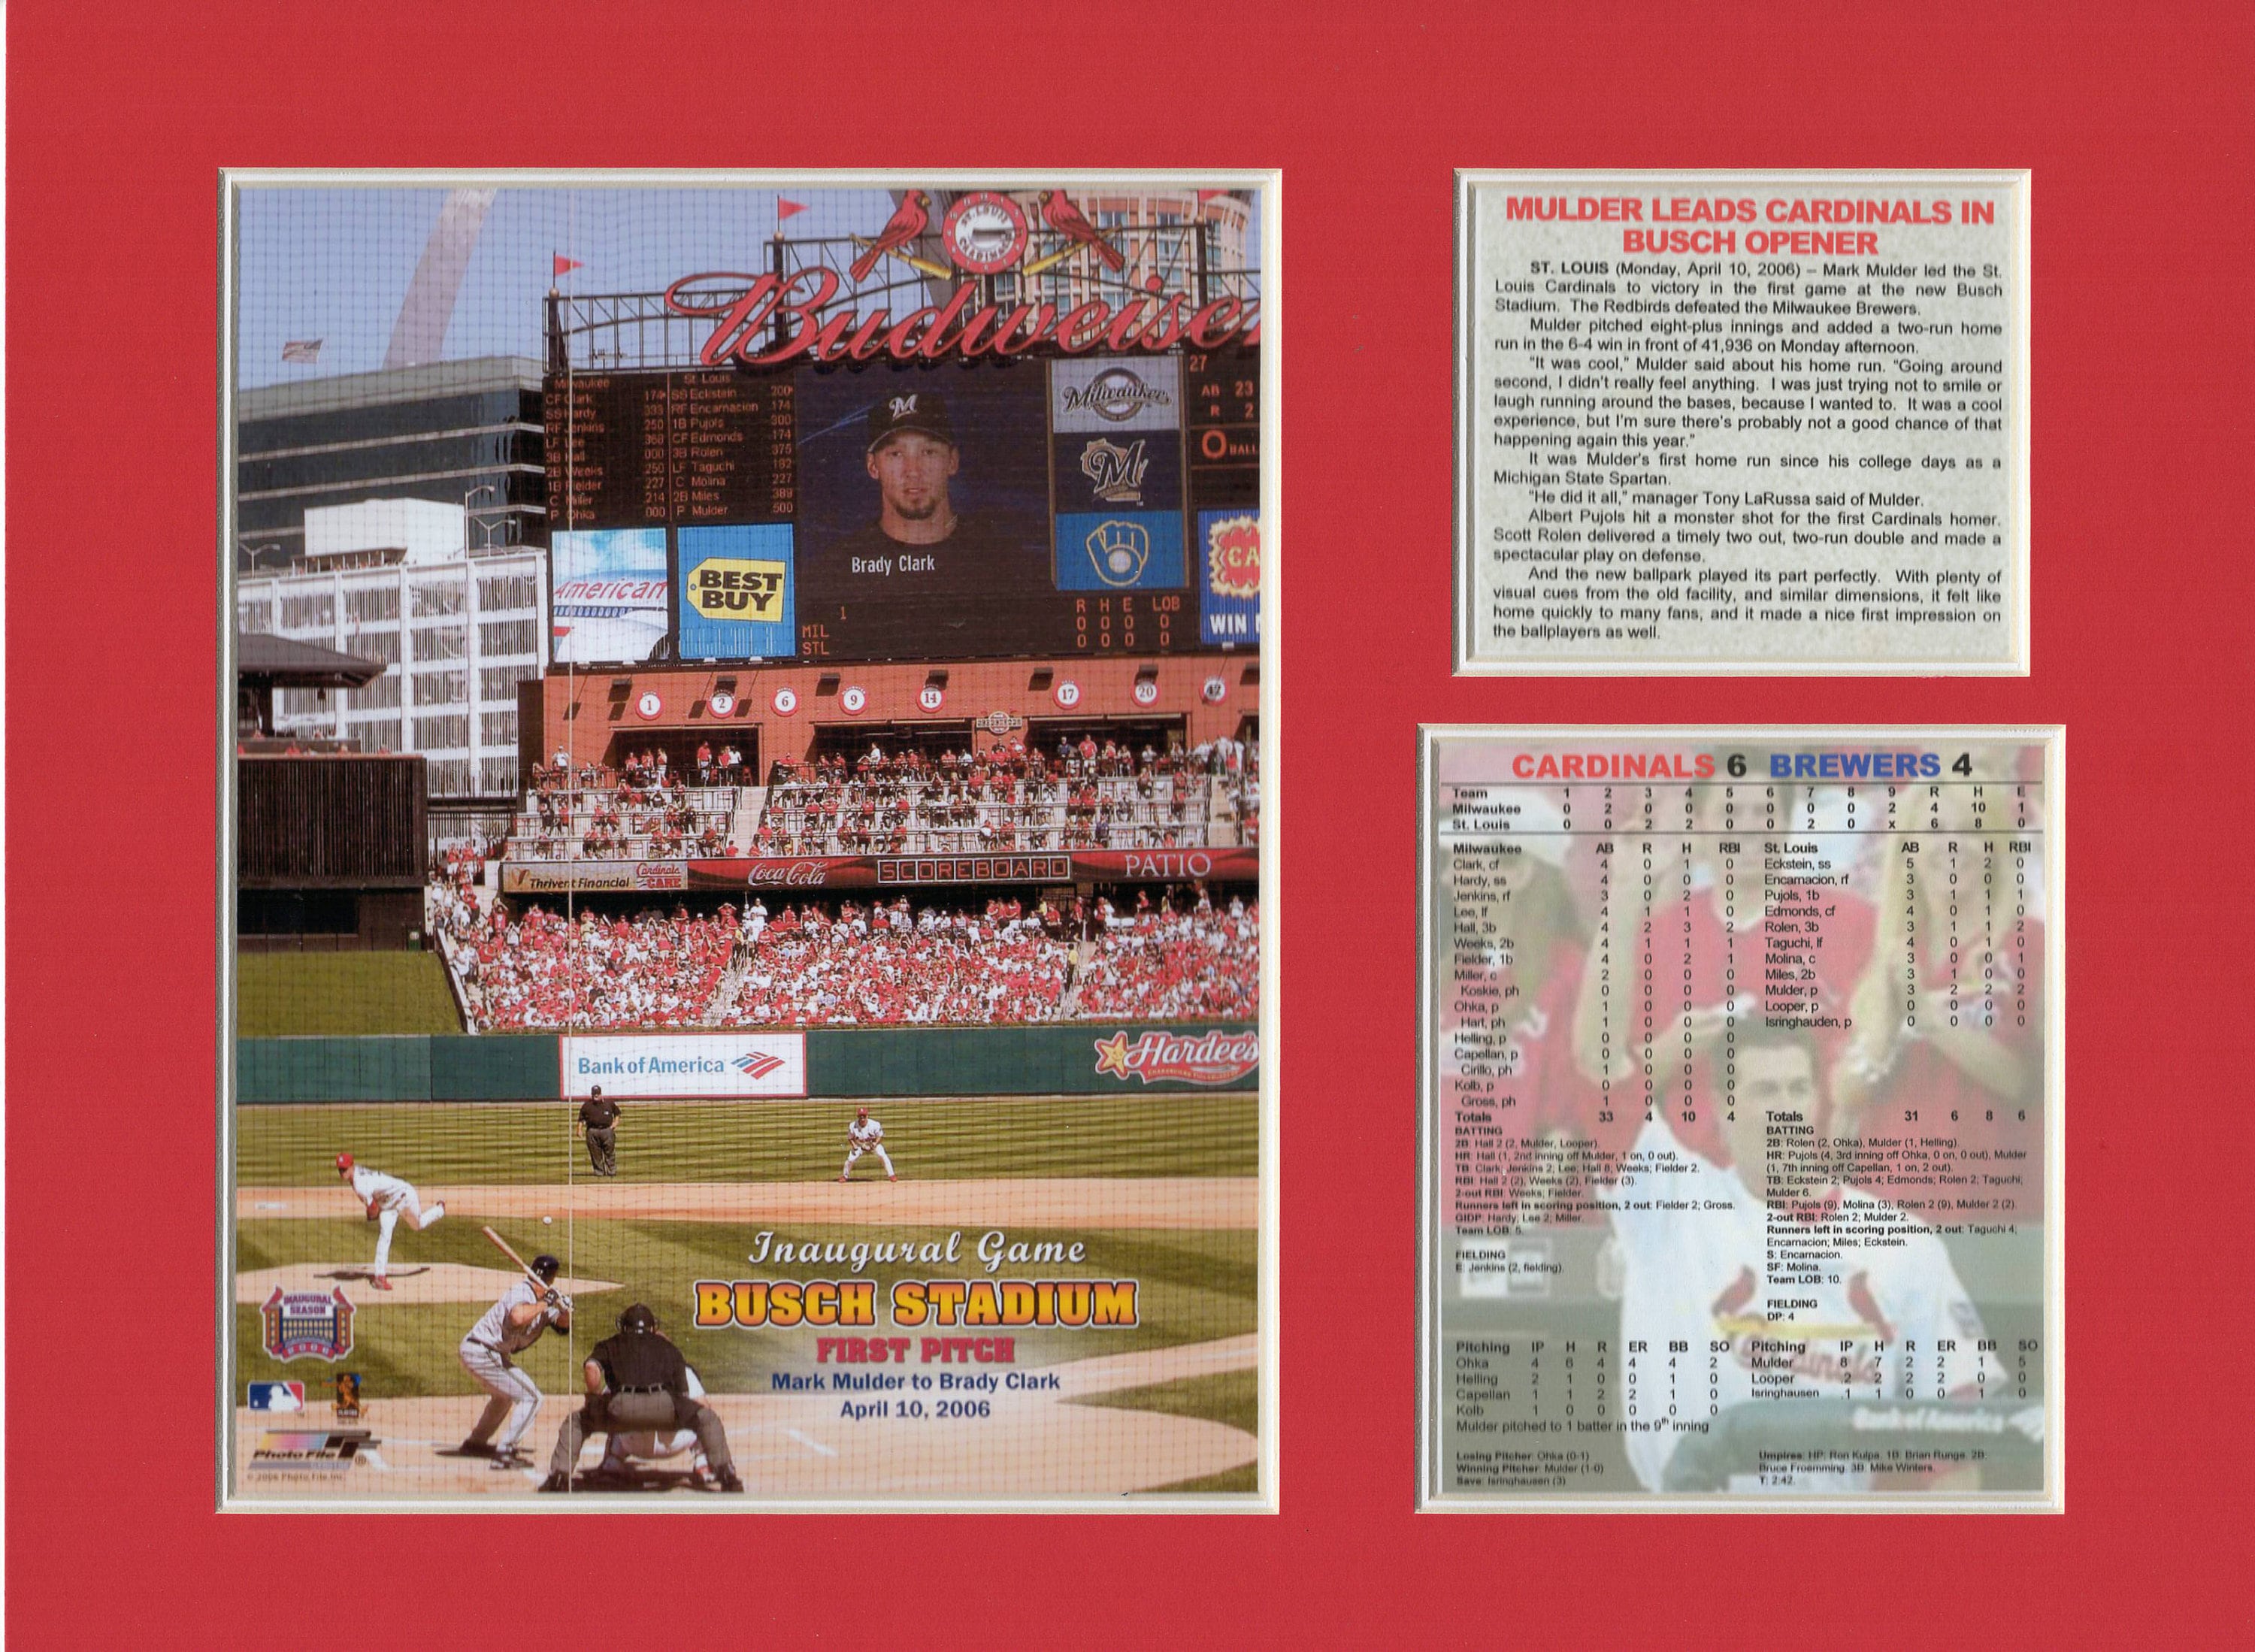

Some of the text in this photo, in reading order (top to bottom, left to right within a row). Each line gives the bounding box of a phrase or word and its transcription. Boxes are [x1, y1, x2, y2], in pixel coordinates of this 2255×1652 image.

[1506, 196, 1994, 225] MULDER LEADS CARDINALS IN
[1623, 228, 1879, 255] BUSCH OPENER
[1530, 260, 2002, 280] ST. LOUIS (Monday, April 10, 2006) Mark Mulder led the St.
[1190, 355, 1207, 372] 27
[702, 374, 731, 384] Louis
[690, 388, 737, 399] Eckstein
[1235, 380, 1254, 397] 23
[546, 394, 561, 405] CF
[690, 402, 758, 413] Encarnacion
[1245, 402, 1254, 419] 2
[673, 419, 686, 429] 1B
[691, 418, 725, 430] Pujols
[673, 431, 743, 443] CF Edmonds
[691, 448, 723, 457] Rolen
[673, 461, 734, 474] LF Taguchi
[692, 474, 792, 486] Molina 227
[646, 492, 664, 503] 214
[673, 491, 719, 502] 2B Miles
[1560, 489, 1583, 504] did
[1588, 490, 1596, 504] it
[1632, 493, 1699, 507] manager
[1702, 490, 1740, 509] Tony
[1745, 491, 1811, 506] LaRussa
[1815, 492, 1846, 507] said
[1850, 492, 1866, 507] of
[1869, 492, 1924, 507] Mulder.
[646, 507, 665, 518] 000
[692, 503, 793, 516] Mulder 500
[852, 555, 936, 576] Brady Clark
[699, 569, 782, 592] BEST
[701, 590, 775, 612] BUY
[1152, 596, 1181, 612] LOB
[840, 606, 846, 620] 1
[1210, 614, 1248, 635] WIN
[802, 625, 829, 639] MIL
[802, 642, 829, 655] STL
[925, 692, 937, 703] 14
[1061, 688, 1075, 700] 17
[1138, 685, 1154, 698] 20
[1512, 752, 1973, 779] CARDINALS 6 BREWERS 4
[1453, 843, 1522, 855] Milwaukee
[1764, 842, 1819, 855] St. Louis
[881, 856, 1067, 880] SCOREBOARD
[1126, 852, 1211, 878] PATIO
[1764, 858, 1832, 871] Eckstein, ss
[530, 876, 629, 889] Thrivent Financial
[646, 878, 682, 888] CARE
[1766, 1016, 1852, 1031] Isringhauden, p
[579, 1056, 725, 1074] Bank of America
[1765, 1110, 1804, 1123] Totals
[1766, 1224, 2017, 1238] Runners left in scoring position, 2 out: Taguchi 4;
[749, 1230, 1086, 1273] Inaugural Game
[283, 1293, 333, 1305] INAUGURAL
[694, 1280, 1139, 1328] BUSCH STADIUM
[1766, 1298, 1818, 1309] FIELDING
[290, 1305, 326, 1315] SEASON
[816, 1337, 1016, 1363] FIRST PITCH
[1456, 1339, 1730, 1356] Pitching IP ER BB SO
[772, 1372, 1061, 1393] Mark Mulder to Brady Clark
[841, 1400, 991, 1420] April 10, 2006
[1456, 1417, 1709, 1435] Mulder pitched to 1 batter in the 9th inning
[253, 1449, 335, 1459] Photo File
[1456, 1463, 1605, 1475] Winning Pitcher: Mulder (1-0)
